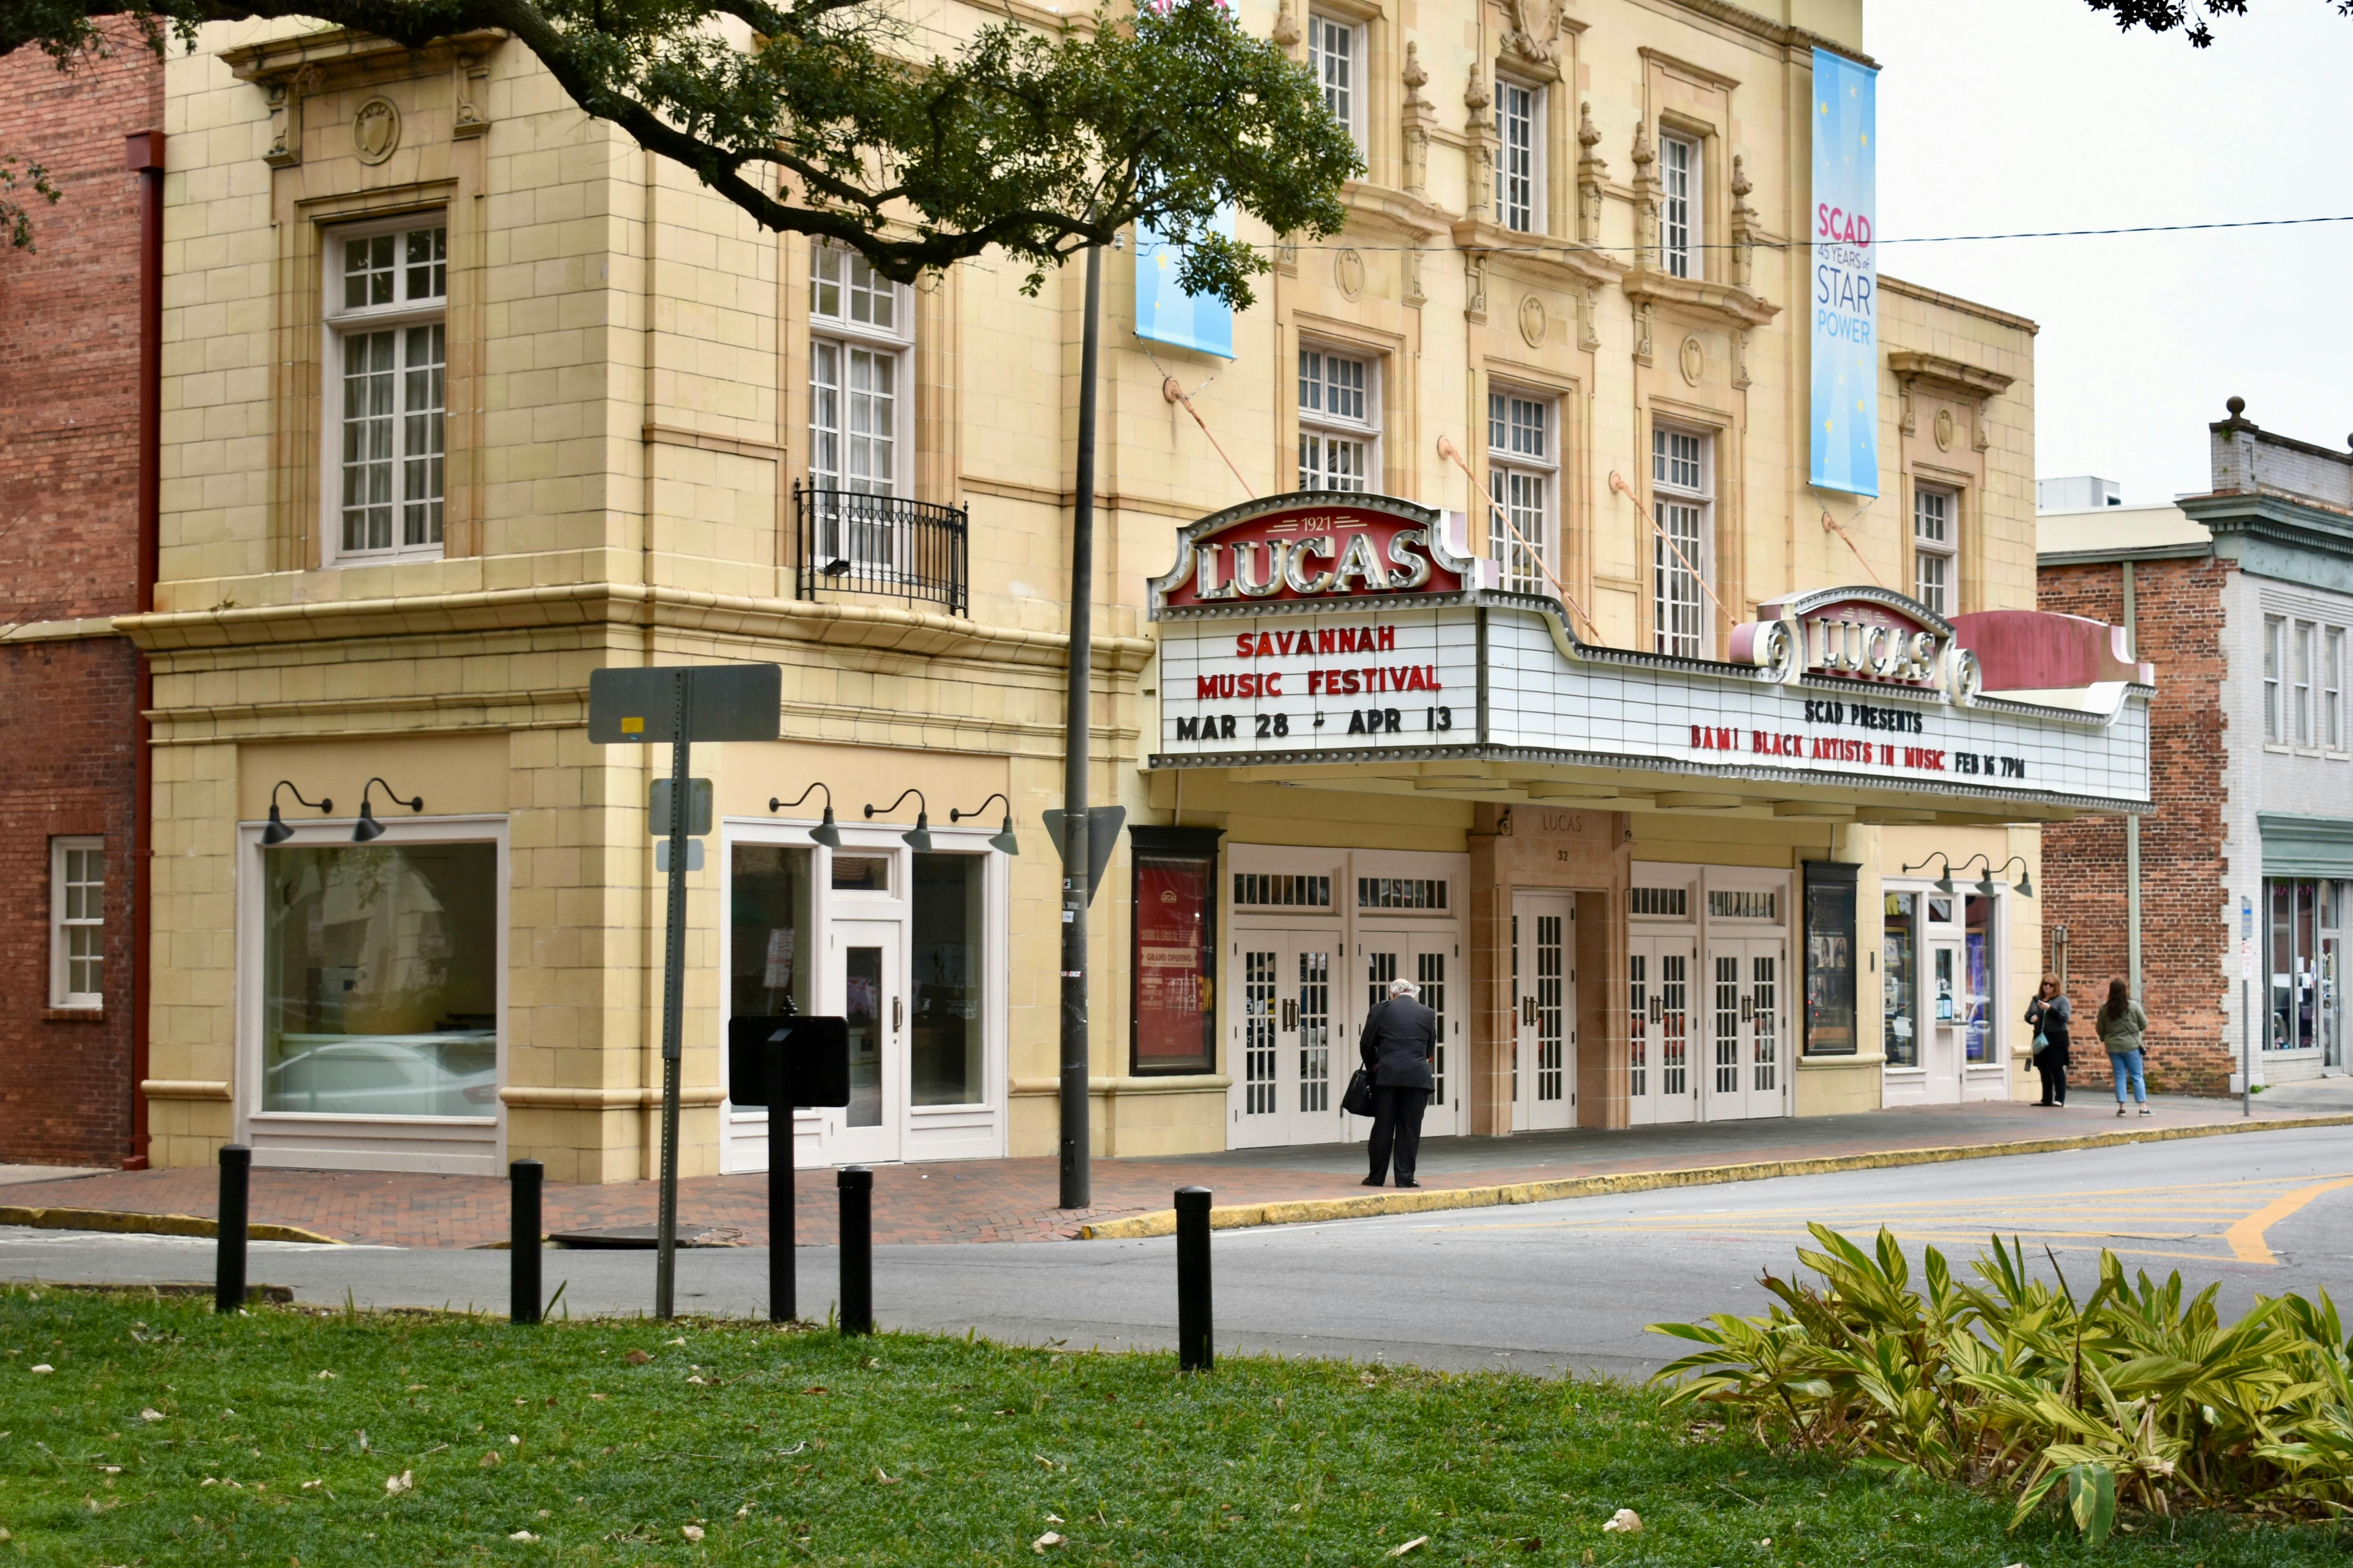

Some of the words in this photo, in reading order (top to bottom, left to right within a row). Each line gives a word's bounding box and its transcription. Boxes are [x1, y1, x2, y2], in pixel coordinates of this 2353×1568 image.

[1818, 203, 1871, 248] SCAD
[1818, 243, 1829, 260] 45
[1831, 245, 1861, 269] YEARS
[1862, 258, 1870, 270] of
[1818, 264, 1870, 316] STAR
[1818, 309, 1870, 346] POWER
[1302, 516, 1330, 532] 1921
[1192, 529, 1431, 600] LUCAS
[1858, 608, 1872, 622] 1921
[1236, 625, 1394, 657] SAVANNAH
[1807, 617, 1936, 681] LUCAS
[1197, 672, 1282, 699] MUSIC
[1308, 665, 1442, 695] FESTIVAL
[1177, 715, 1236, 741] MAR
[1256, 713, 1289, 737] 28
[1347, 708, 1401, 734] APR
[1427, 706, 1452, 731] 13
[1805, 700, 1844, 725] SCAD
[1851, 703, 1922, 734] PRESENTS
[1691, 725, 1738, 750] BAM!
[1753, 730, 1802, 757] BLACK
[1812, 737, 1872, 764] ARTISTS
[1880, 744, 1894, 766] IN
[1904, 746, 1945, 771] MUSIC
[1955, 751, 1979, 774] FEB
[1984, 754, 1994, 776] 16
[2001, 756, 2024, 778] 7PM
[1543, 814, 1582, 832] LUCAS
[1558, 850, 1568, 861] 32
[1147, 953, 1166, 962] GRAND
[1167, 954, 1192, 962] OPENING
